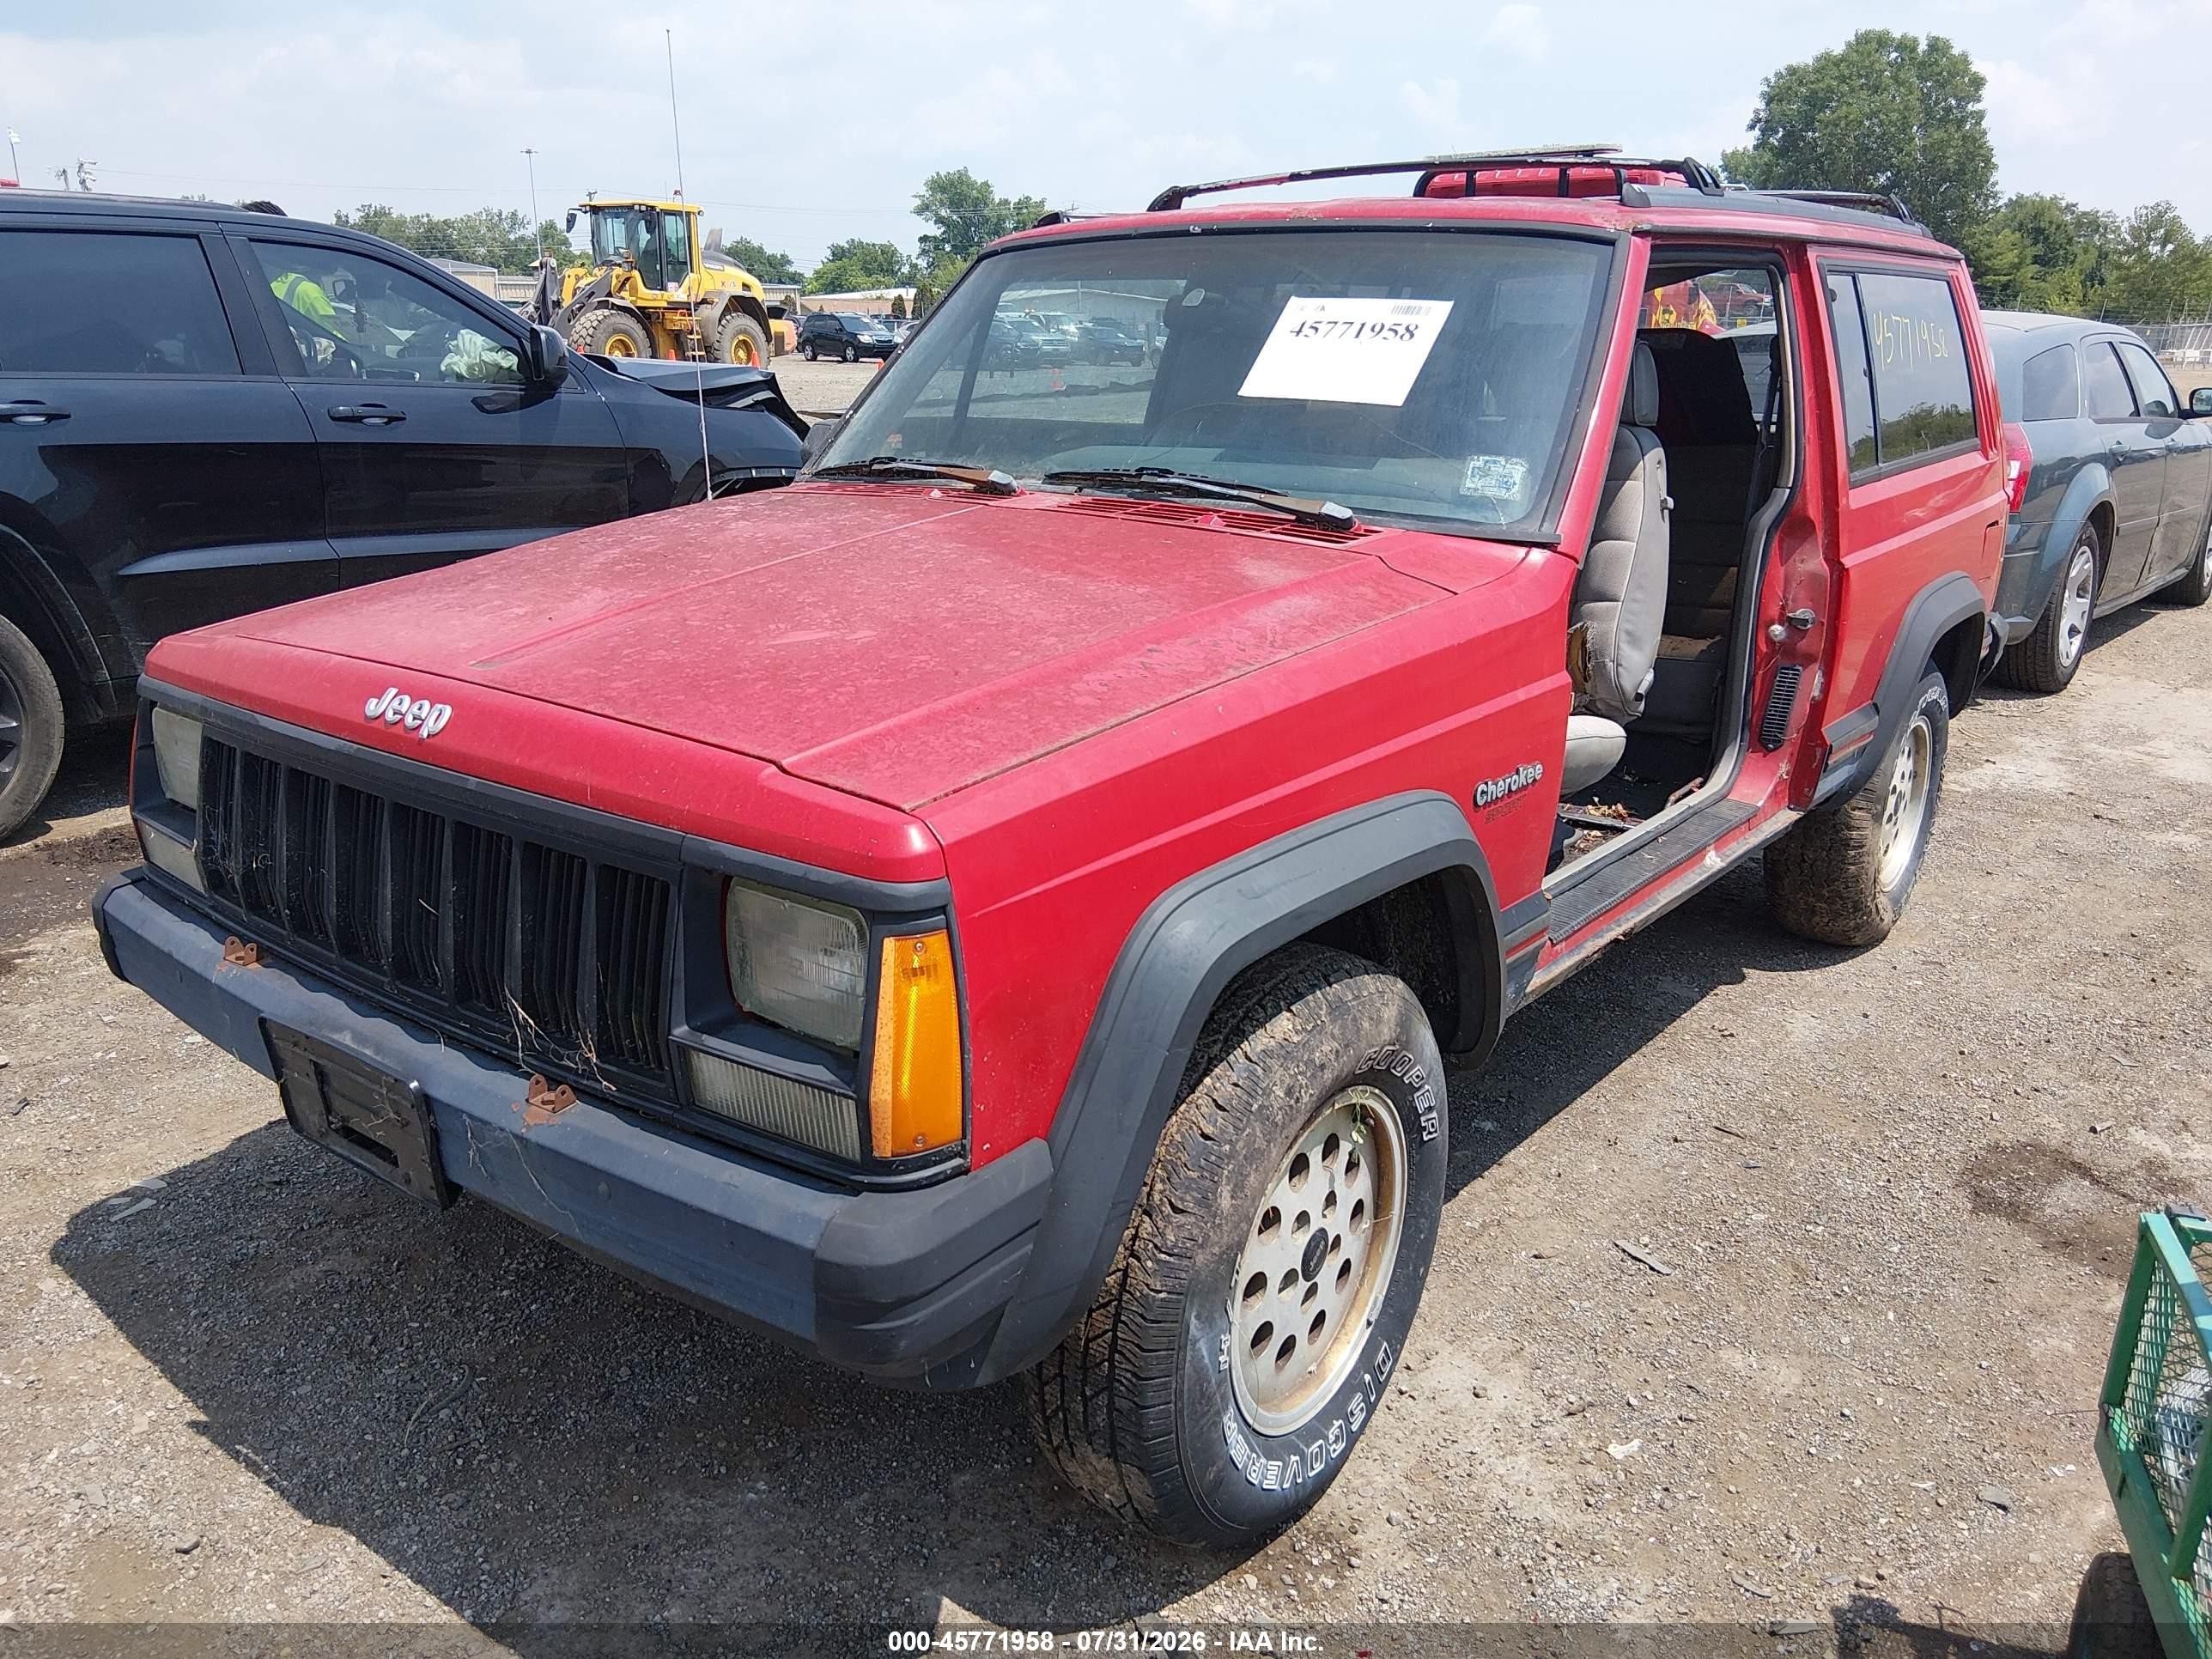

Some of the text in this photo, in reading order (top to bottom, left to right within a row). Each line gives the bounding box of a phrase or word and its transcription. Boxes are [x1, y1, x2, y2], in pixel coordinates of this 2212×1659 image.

[1290, 319, 1419, 342] 45771958
[1873, 309, 1948, 371] 45771958
[364, 687, 453, 739] Jeep
[1474, 763, 1544, 808] Cherokee
[1354, 1045, 1440, 1141] COOPER
[1221, 1341, 1393, 1490] DISCOVERER
